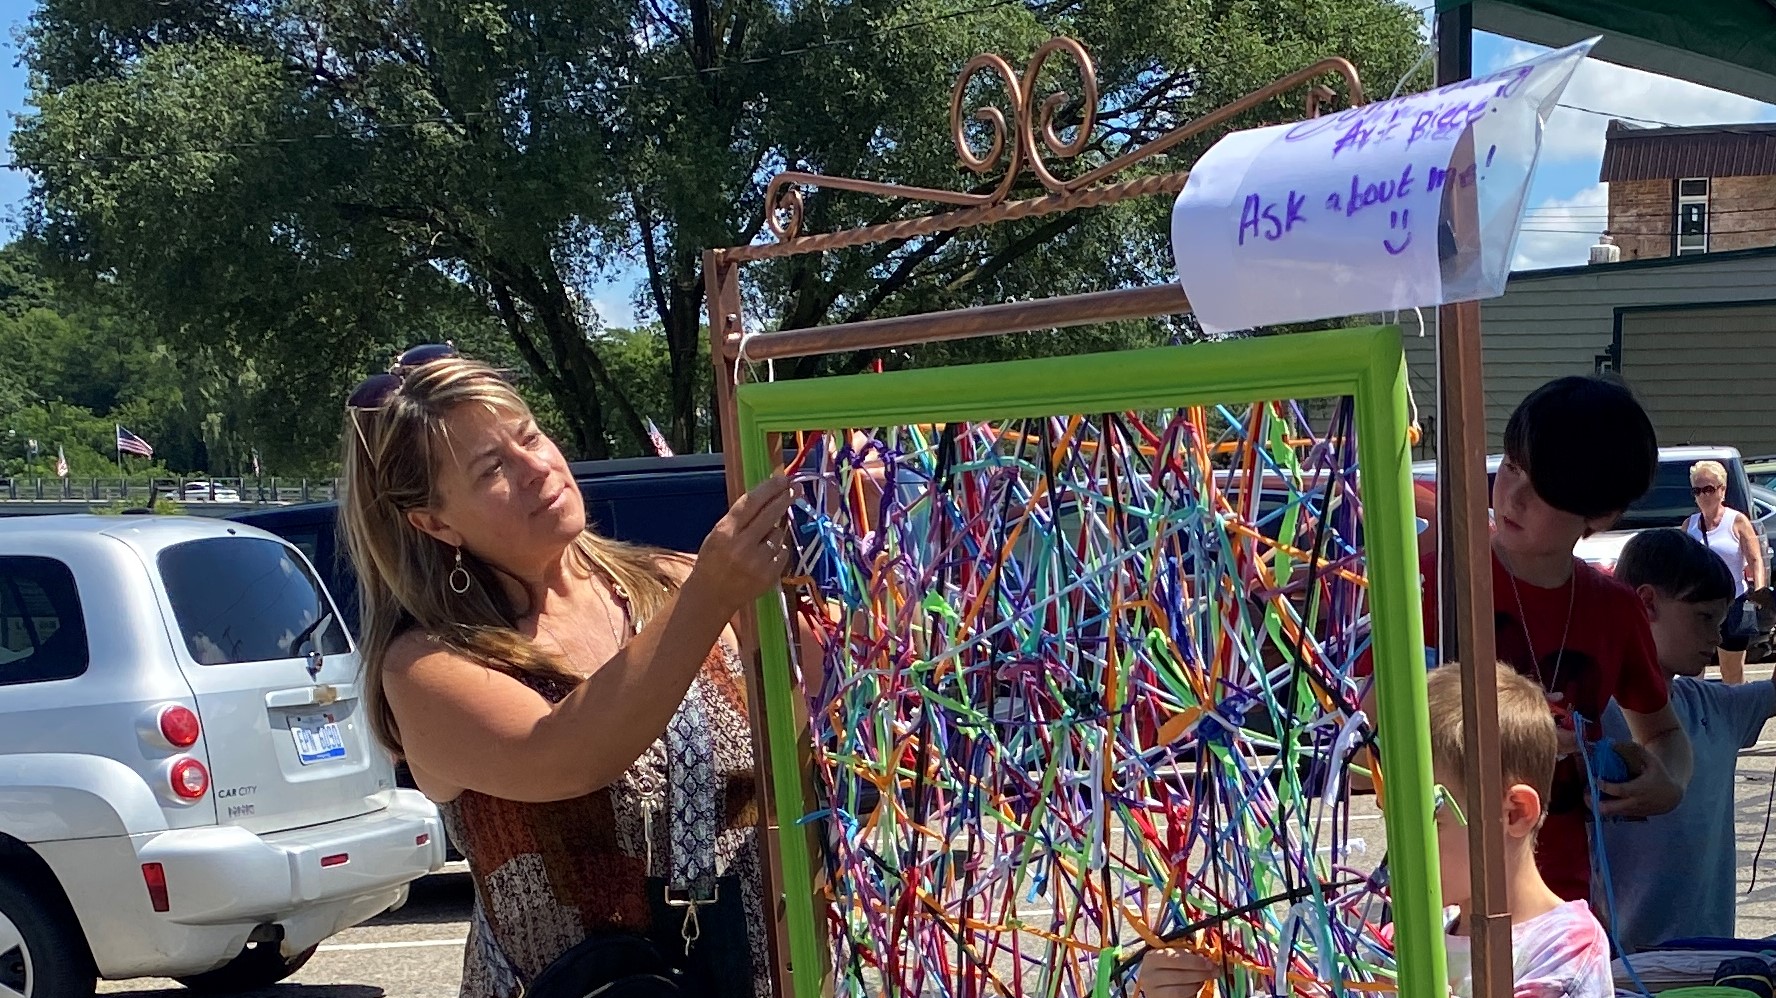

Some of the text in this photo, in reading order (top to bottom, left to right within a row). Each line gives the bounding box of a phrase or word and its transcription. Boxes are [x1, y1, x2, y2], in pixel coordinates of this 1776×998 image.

[1325, 163, 1415, 217] about
[1426, 144, 1497, 193] me!
[218, 785, 257, 798] CAR CITY
